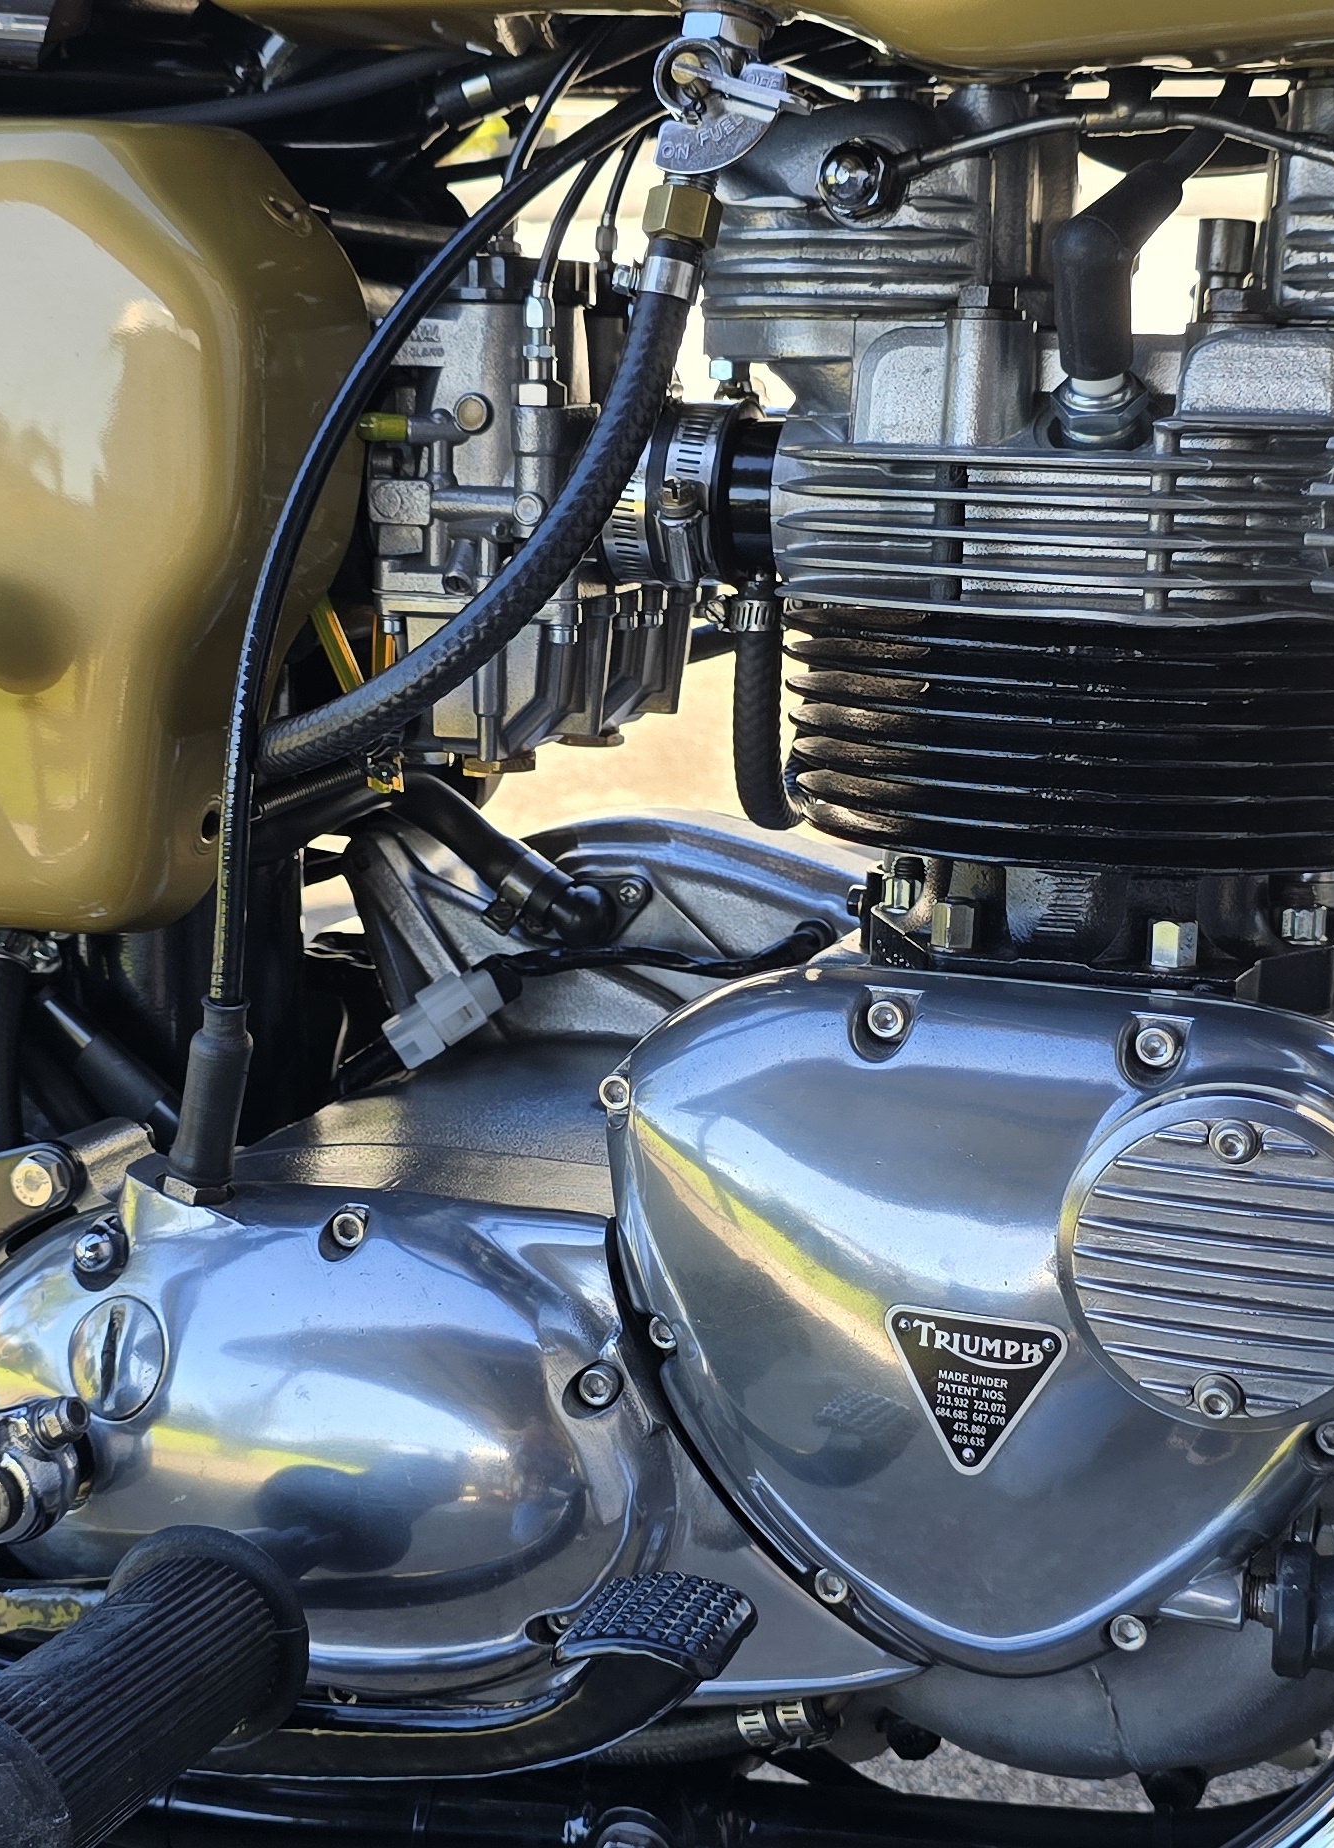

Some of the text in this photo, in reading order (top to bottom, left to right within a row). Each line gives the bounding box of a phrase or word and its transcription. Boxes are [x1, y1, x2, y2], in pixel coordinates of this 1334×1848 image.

[660, 113, 745, 160] ON FUEL
[912, 1318, 1045, 1370] TRIUMPH
[938, 1369, 1008, 1389] MADE UNDER
[937, 1382, 1007, 1401] PATENT NOS.
[936, 1393, 1007, 1414] 713.932 723.073
[972, 1412, 1006, 1426] 647.670
